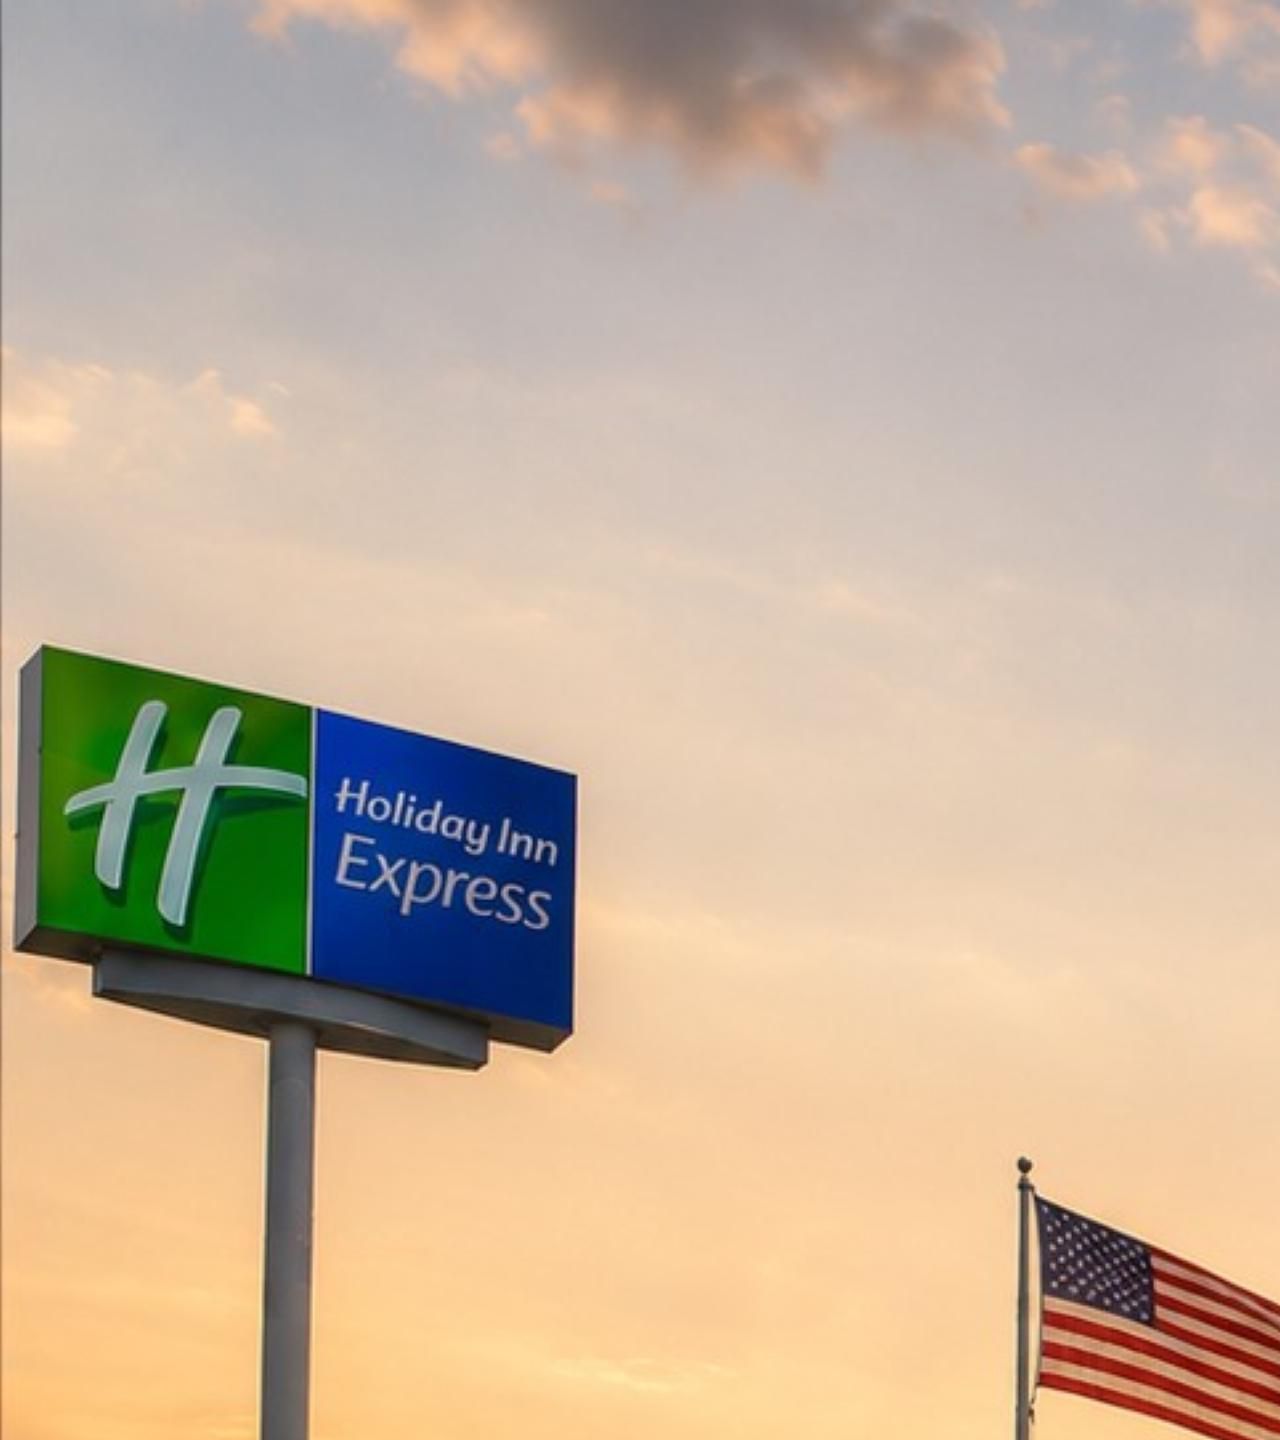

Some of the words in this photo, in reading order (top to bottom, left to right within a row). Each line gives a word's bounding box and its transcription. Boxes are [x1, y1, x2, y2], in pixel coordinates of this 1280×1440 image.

[335, 777, 489, 855] Holiday
[497, 817, 559, 866] Inn
[335, 832, 553, 930] Express
